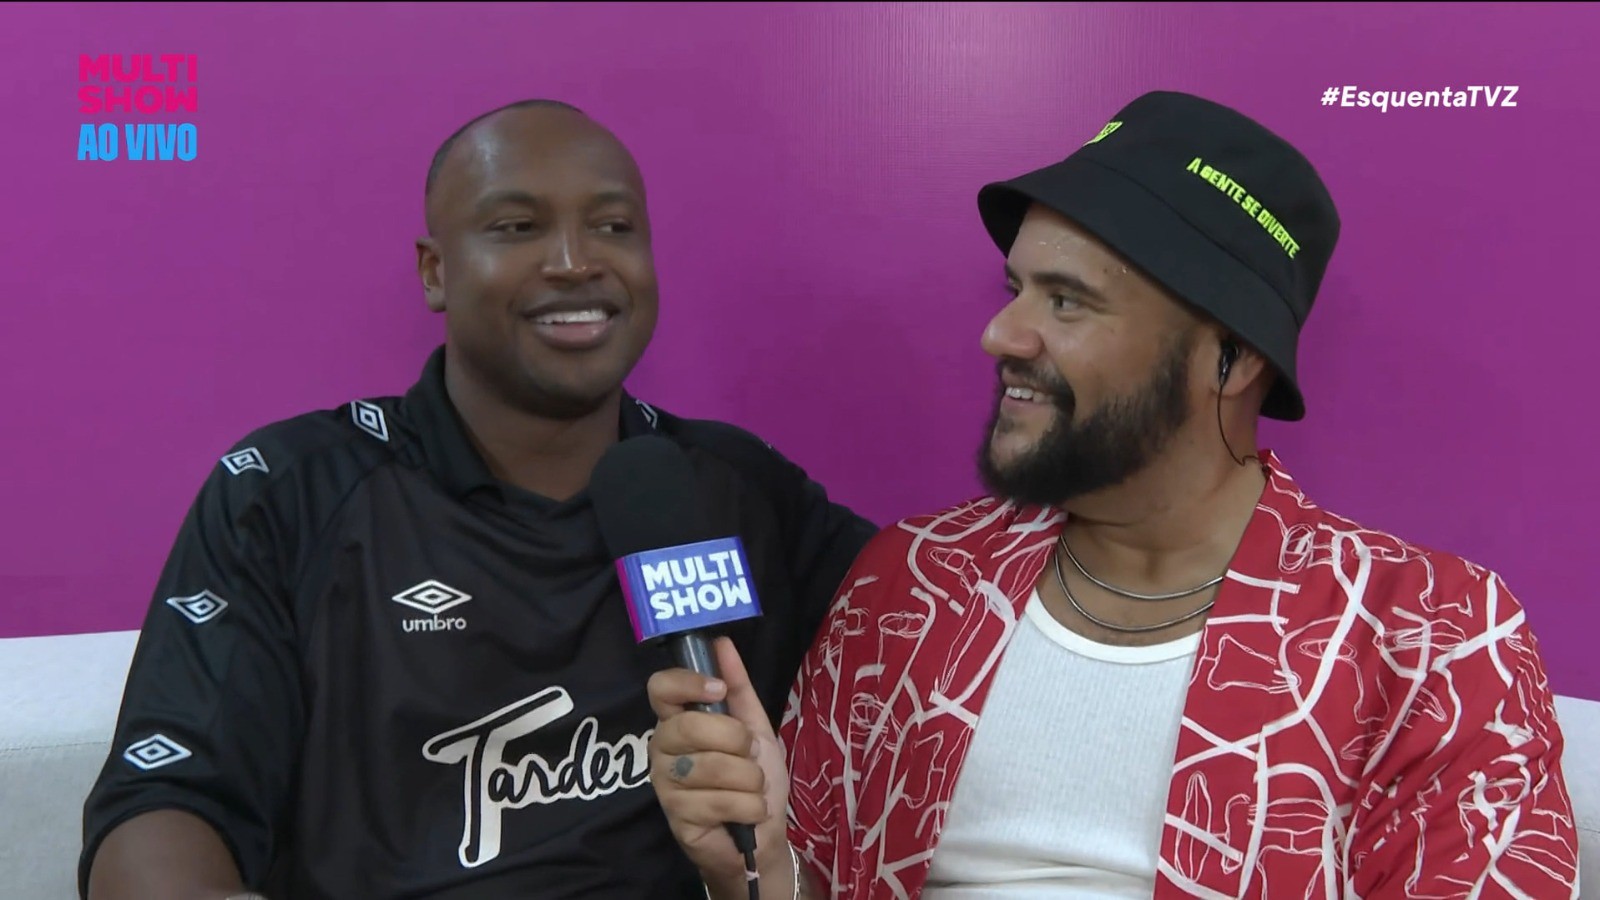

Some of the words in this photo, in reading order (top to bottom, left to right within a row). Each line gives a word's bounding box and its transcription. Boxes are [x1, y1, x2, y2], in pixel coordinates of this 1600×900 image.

[1186, 157, 1202, 174] A
[1200, 165, 1246, 203] GENTE
[1241, 194, 1262, 218] SE
[1256, 208, 1300, 259] DIVERTE
[641, 549, 744, 591] MULTI
[650, 577, 752, 620] SHOW
[402, 613, 467, 632] umbro
[422, 685, 654, 868] Tardez
